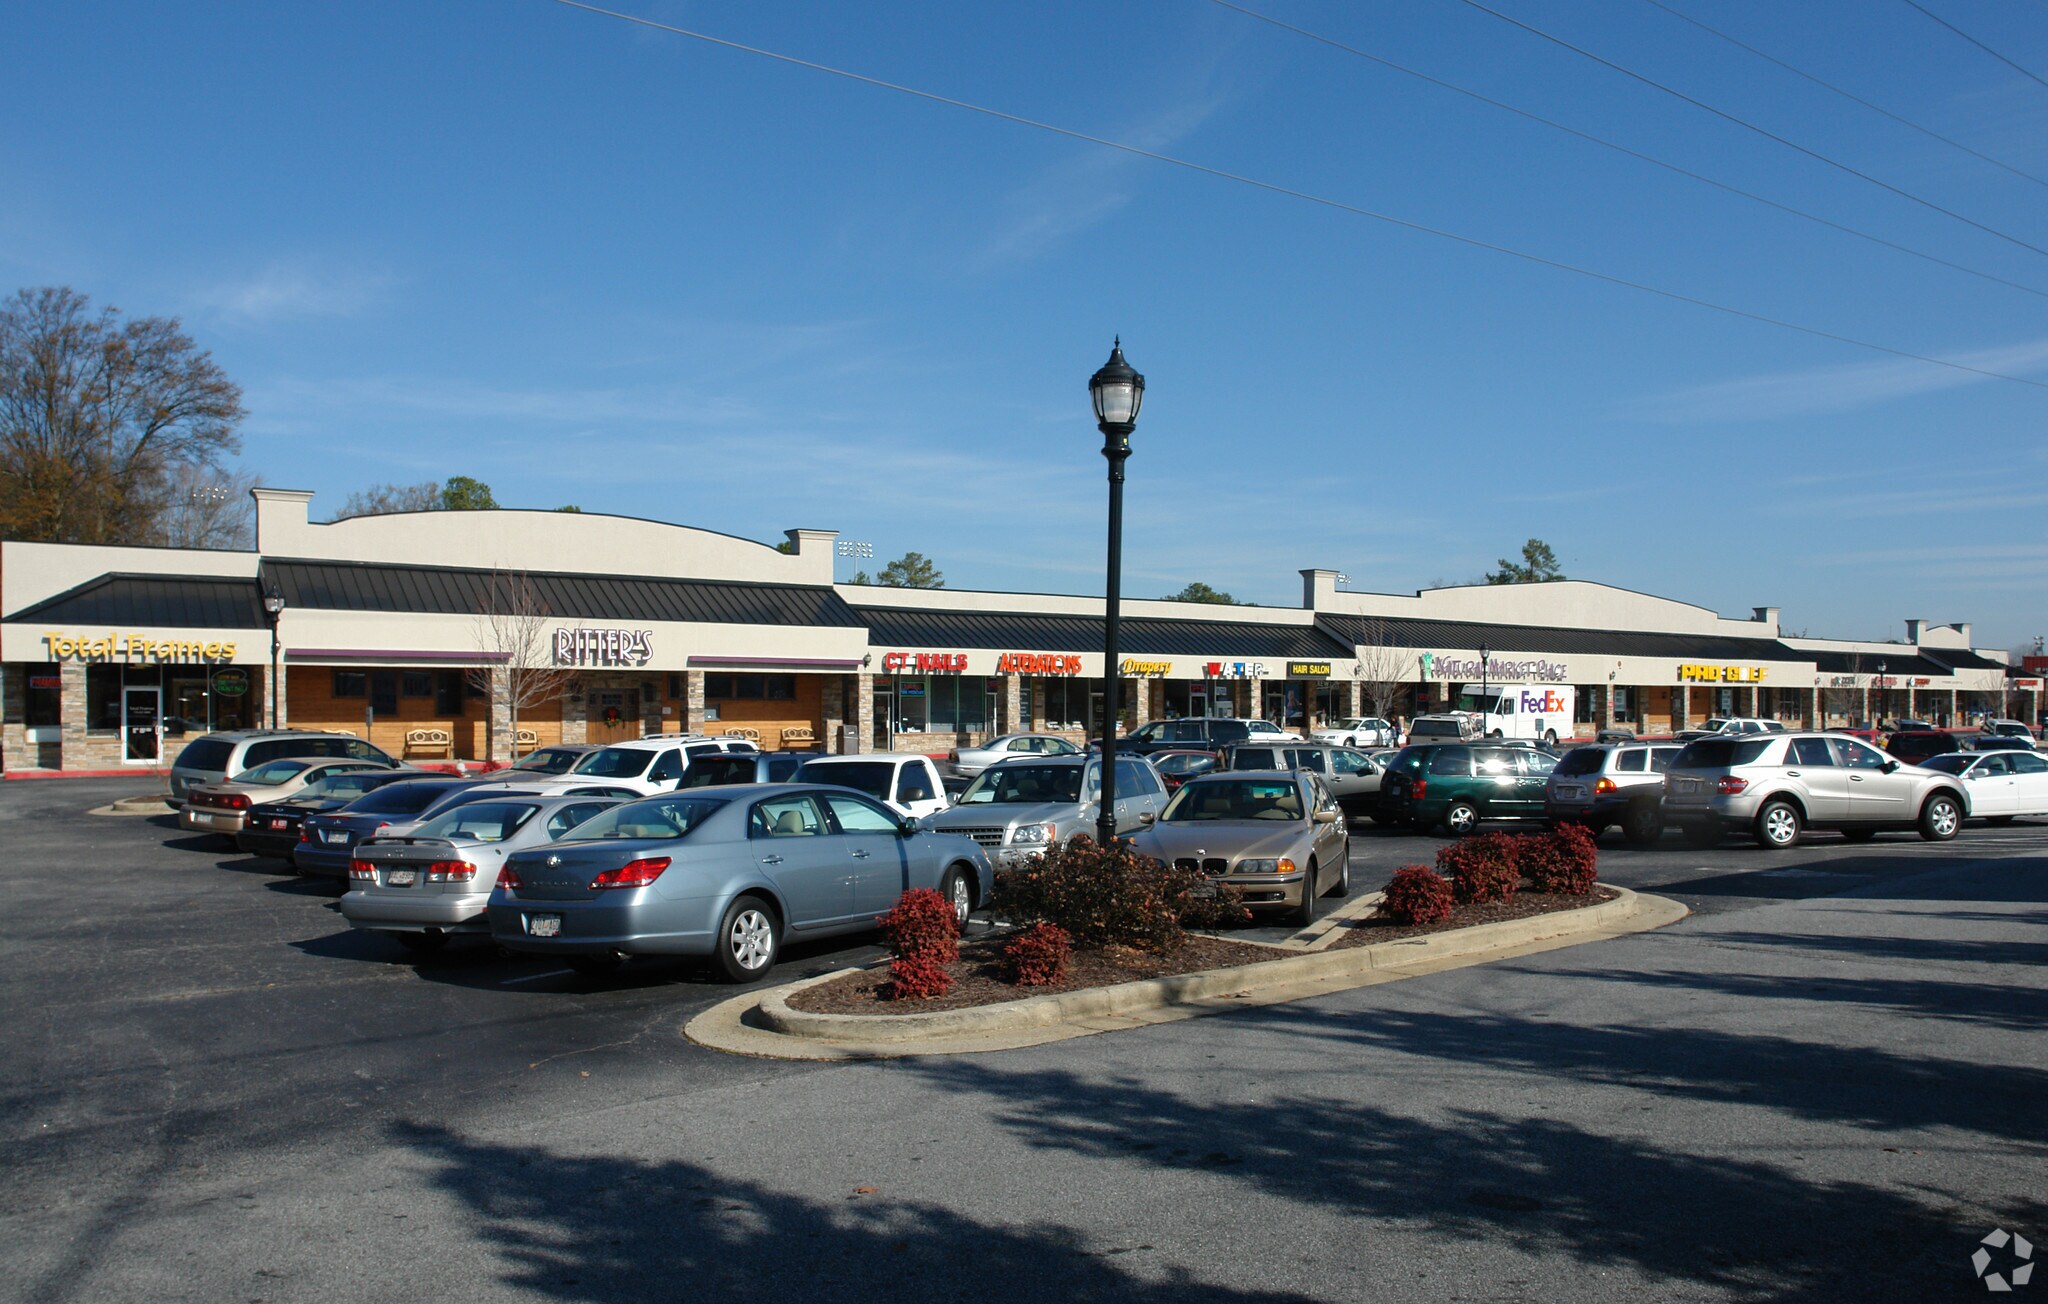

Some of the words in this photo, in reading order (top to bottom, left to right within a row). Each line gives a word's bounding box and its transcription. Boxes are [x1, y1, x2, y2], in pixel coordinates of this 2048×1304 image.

[44, 631, 117, 657] Total
[128, 633, 237, 659] Frames
[557, 628, 653, 660] RITTER'S
[885, 652, 910, 670] CT
[916, 653, 968, 671] NAILS
[1000, 652, 1082, 674] ALTERATIONS
[1123, 658, 1172, 676] Drapery
[1207, 662, 1263, 677] WATER
[1292, 664, 1308, 674] HAIR
[1309, 665, 1330, 675] SALON
[1488, 659, 1536, 678] MARKET
[1537, 660, 1568, 679] PLACE
[1681, 664, 1722, 681] PRO
[1726, 666, 1768, 682] GOLF
[1520, 690, 1565, 713] FedEx
